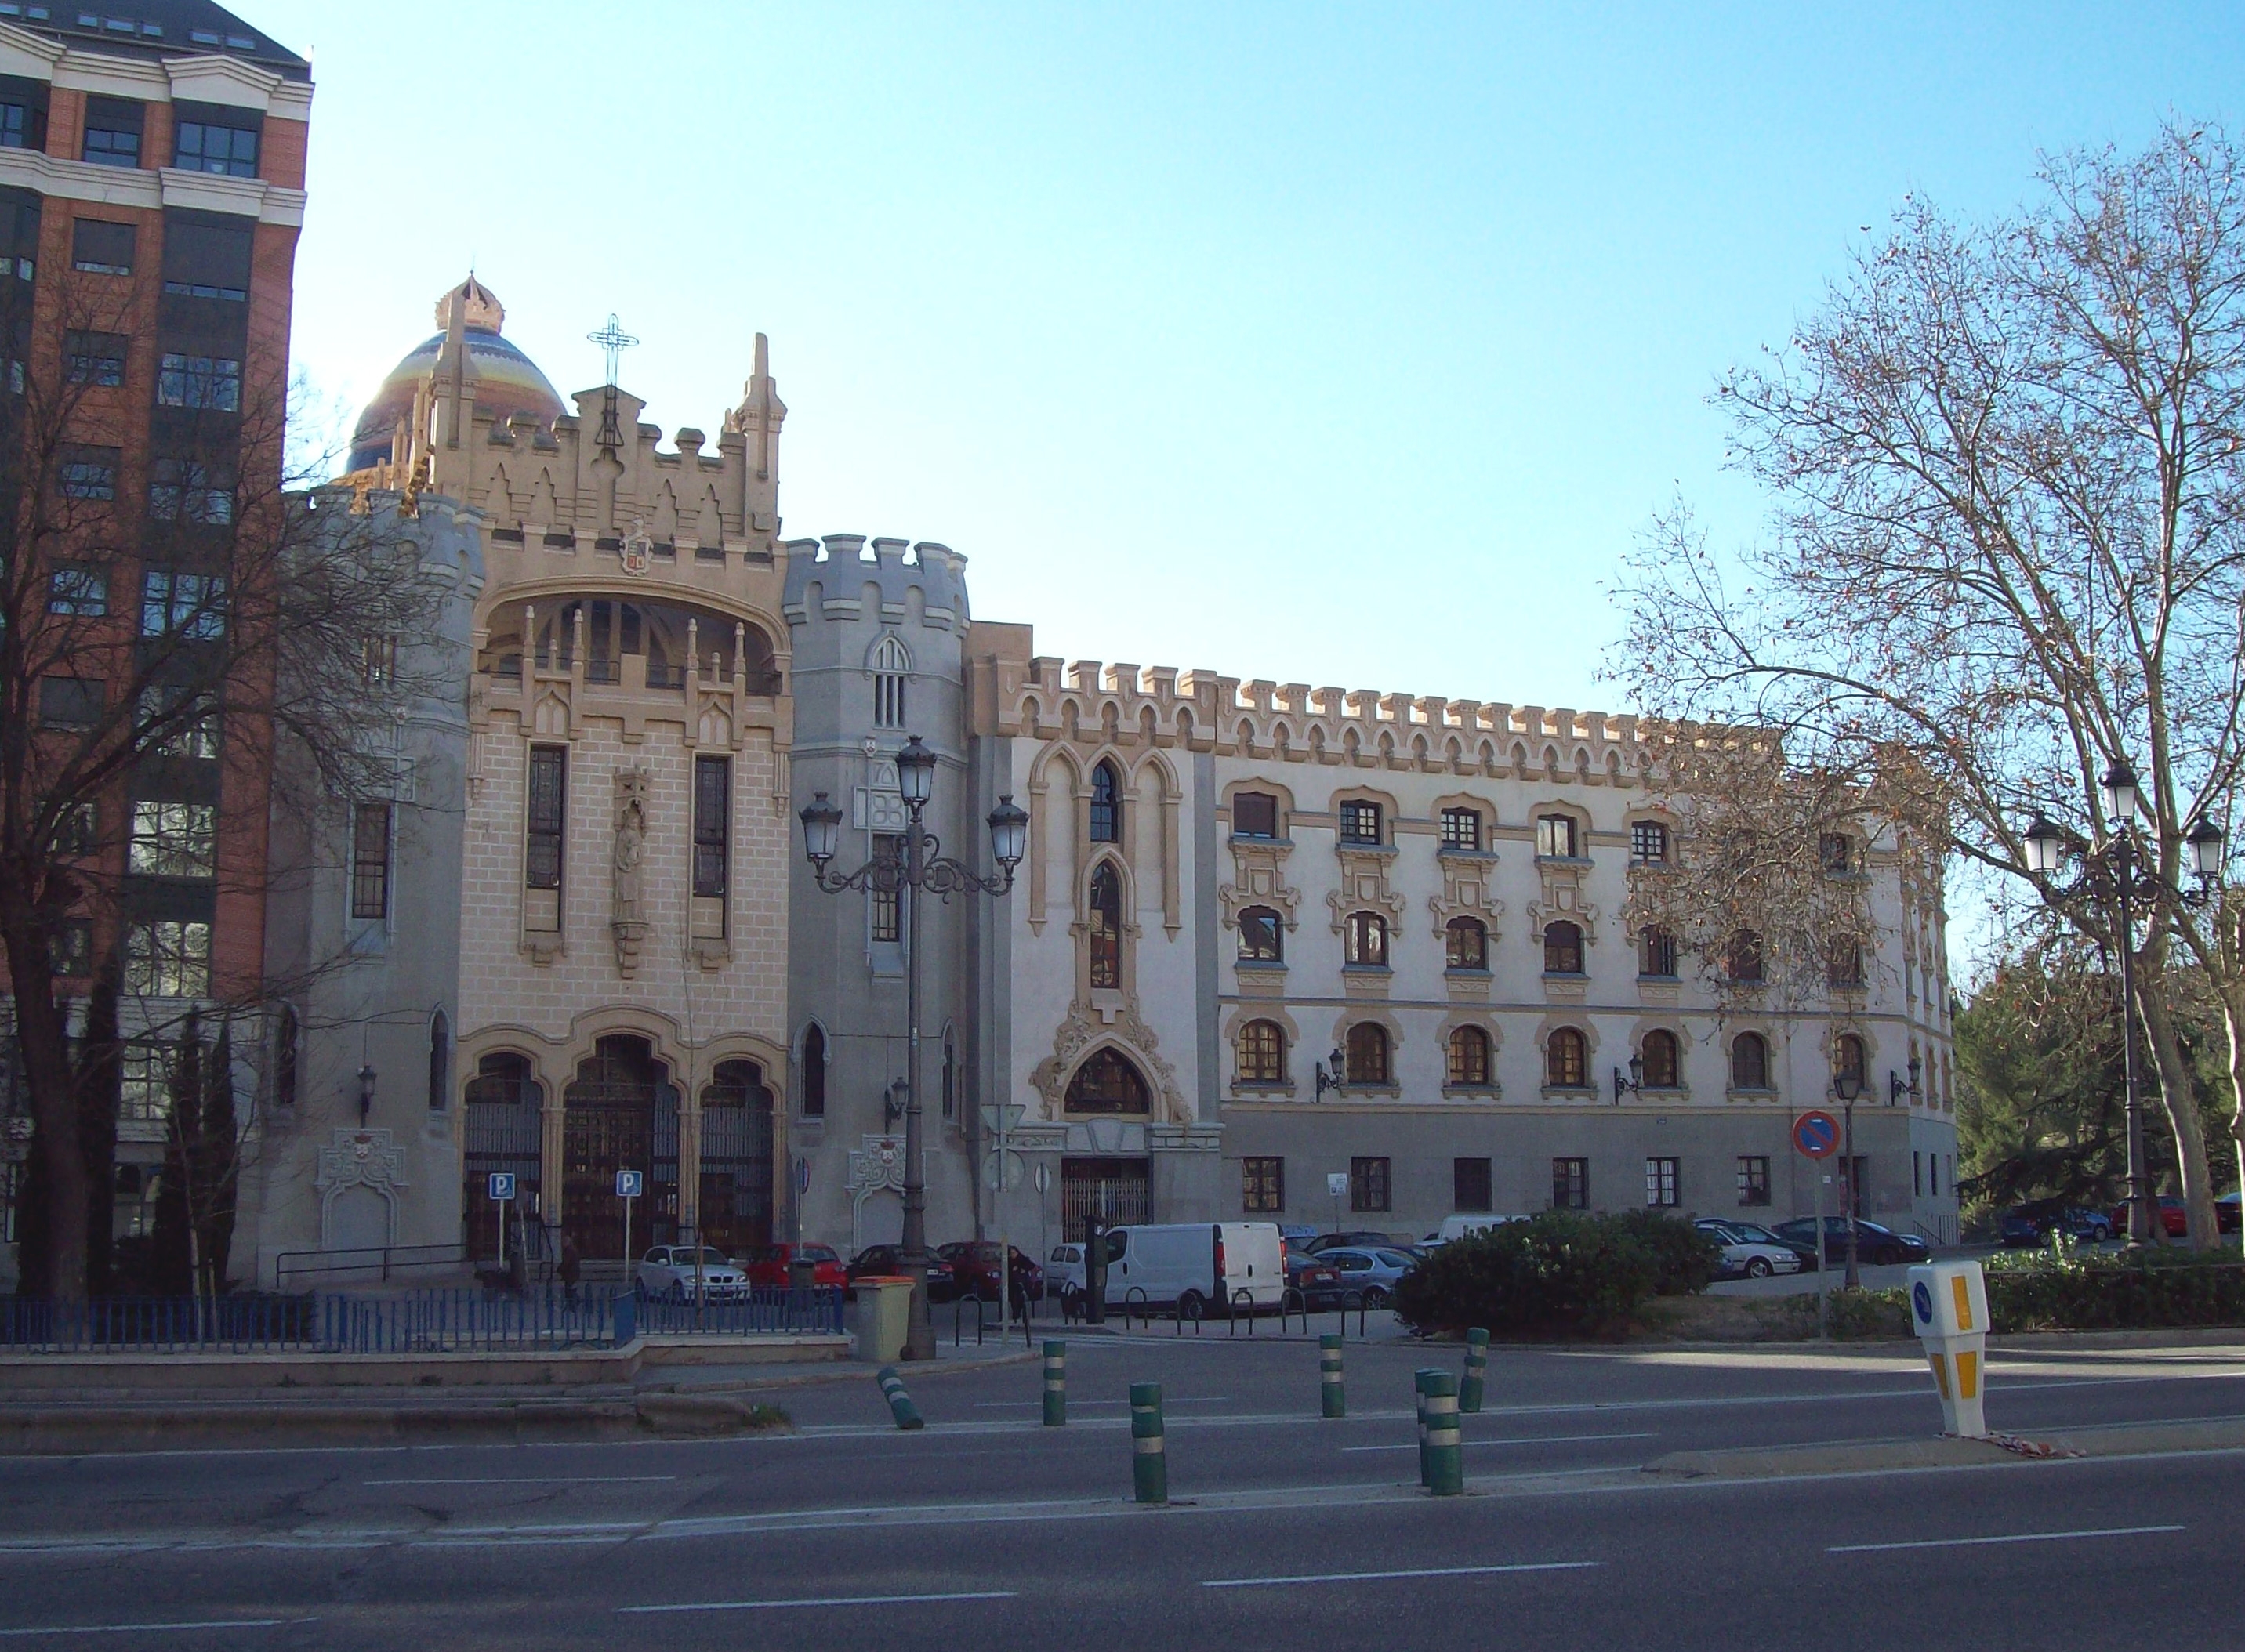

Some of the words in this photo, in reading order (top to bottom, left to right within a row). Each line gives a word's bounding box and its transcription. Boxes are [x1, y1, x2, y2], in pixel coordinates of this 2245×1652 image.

[496, 1176, 508, 1194] P
[622, 1173, 634, 1192] P
[1097, 1225, 1103, 1235] P
